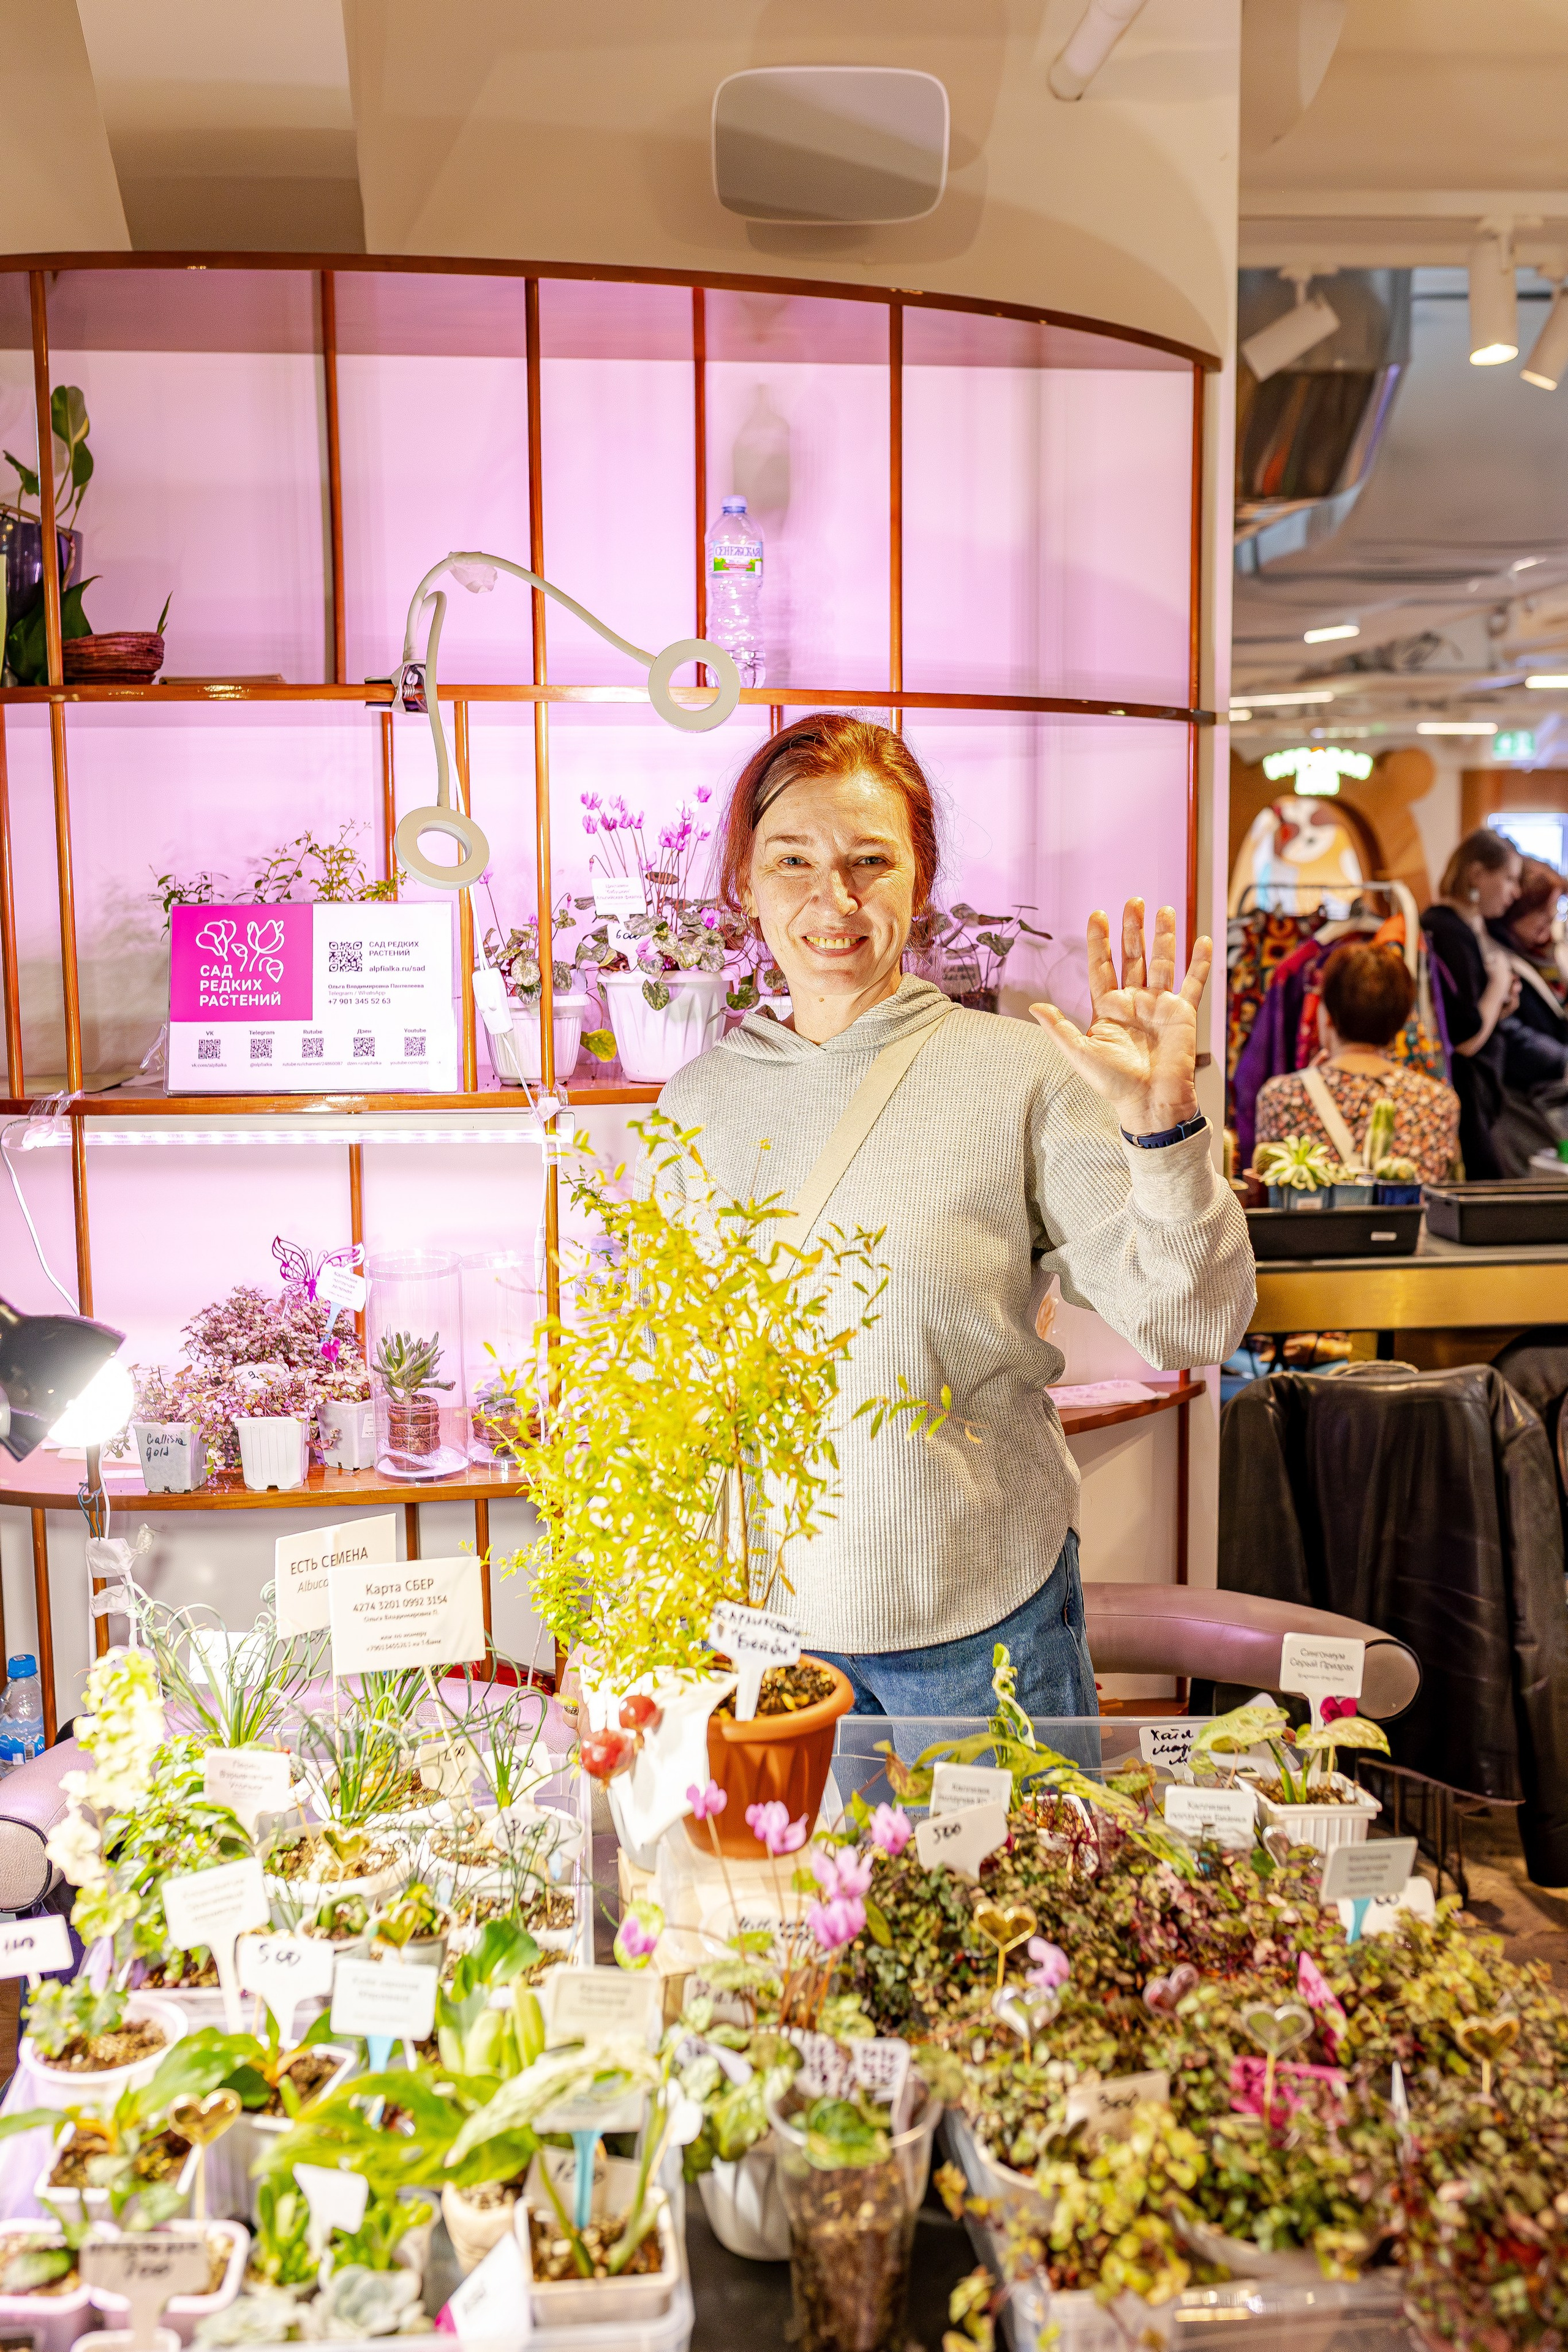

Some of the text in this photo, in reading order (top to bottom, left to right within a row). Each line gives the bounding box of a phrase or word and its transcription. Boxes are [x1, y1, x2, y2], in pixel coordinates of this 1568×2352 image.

[200, 964, 233, 979] САД
[199, 979, 262, 993] РЕДКИХ
[199, 991, 282, 1007] РАСТЕНИЙ
[290, 1546, 368, 1575] ЕСТЬ СЕМЕНА
[366, 1578, 434, 1596] Карта СБЕР
